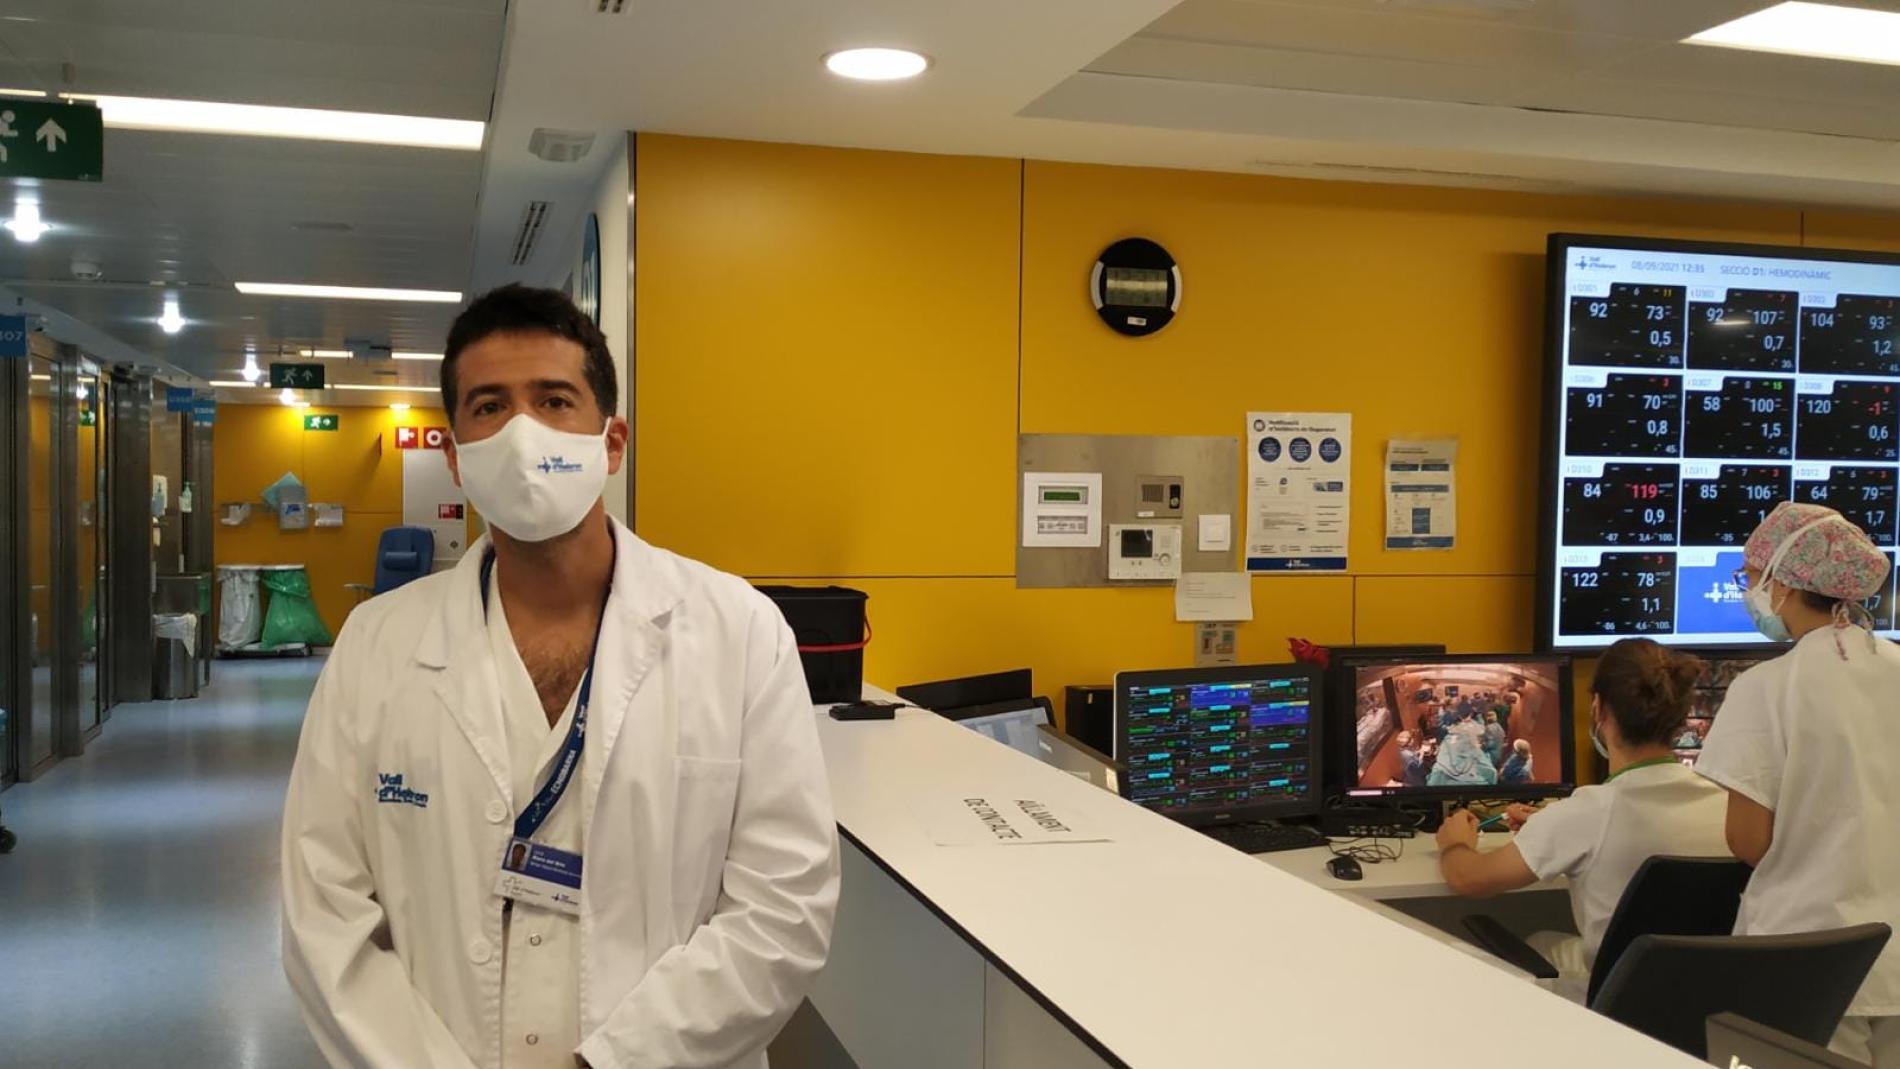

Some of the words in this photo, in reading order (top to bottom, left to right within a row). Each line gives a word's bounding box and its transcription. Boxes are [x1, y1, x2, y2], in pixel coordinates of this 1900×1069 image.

[1589, 303, 1608, 318] 92
[1646, 305, 1664, 320] 73
[1706, 308, 1724, 322] 92
[1753, 311, 1777, 325] 107
[1810, 313, 1834, 327] 104
[1869, 316, 1885, 330] 93
[1650, 331, 1671, 348] 0,5
[1763, 335, 1785, 351] 0,7
[1873, 340, 1892, 356] 1,2
[1586, 393, 1603, 408] 91
[1643, 395, 1661, 410] 70
[1703, 396, 1721, 411] 58
[1750, 399, 1774, 413] 100
[1807, 400, 1831, 414] 120
[1647, 420, 1668, 437] 0,8
[1761, 423, 1781, 439] 1,5
[1868, 426, 1889, 442] 0,6
[1583, 483, 1601, 498] 84
[1632, 484, 1658, 498] 119
[1700, 484, 1718, 499] 85
[1746, 485, 1771, 500] 106
[1811, 486, 1828, 500] 64
[1862, 487, 1878, 501] 79
[1644, 508, 1665, 525] 0,9
[1866, 510, 1885, 526] 1,7
[1572, 573, 1598, 587] 122
[1637, 572, 1655, 587] 78
[1642, 598, 1660, 613] 1,1
[379, 773, 403, 785] Vall
